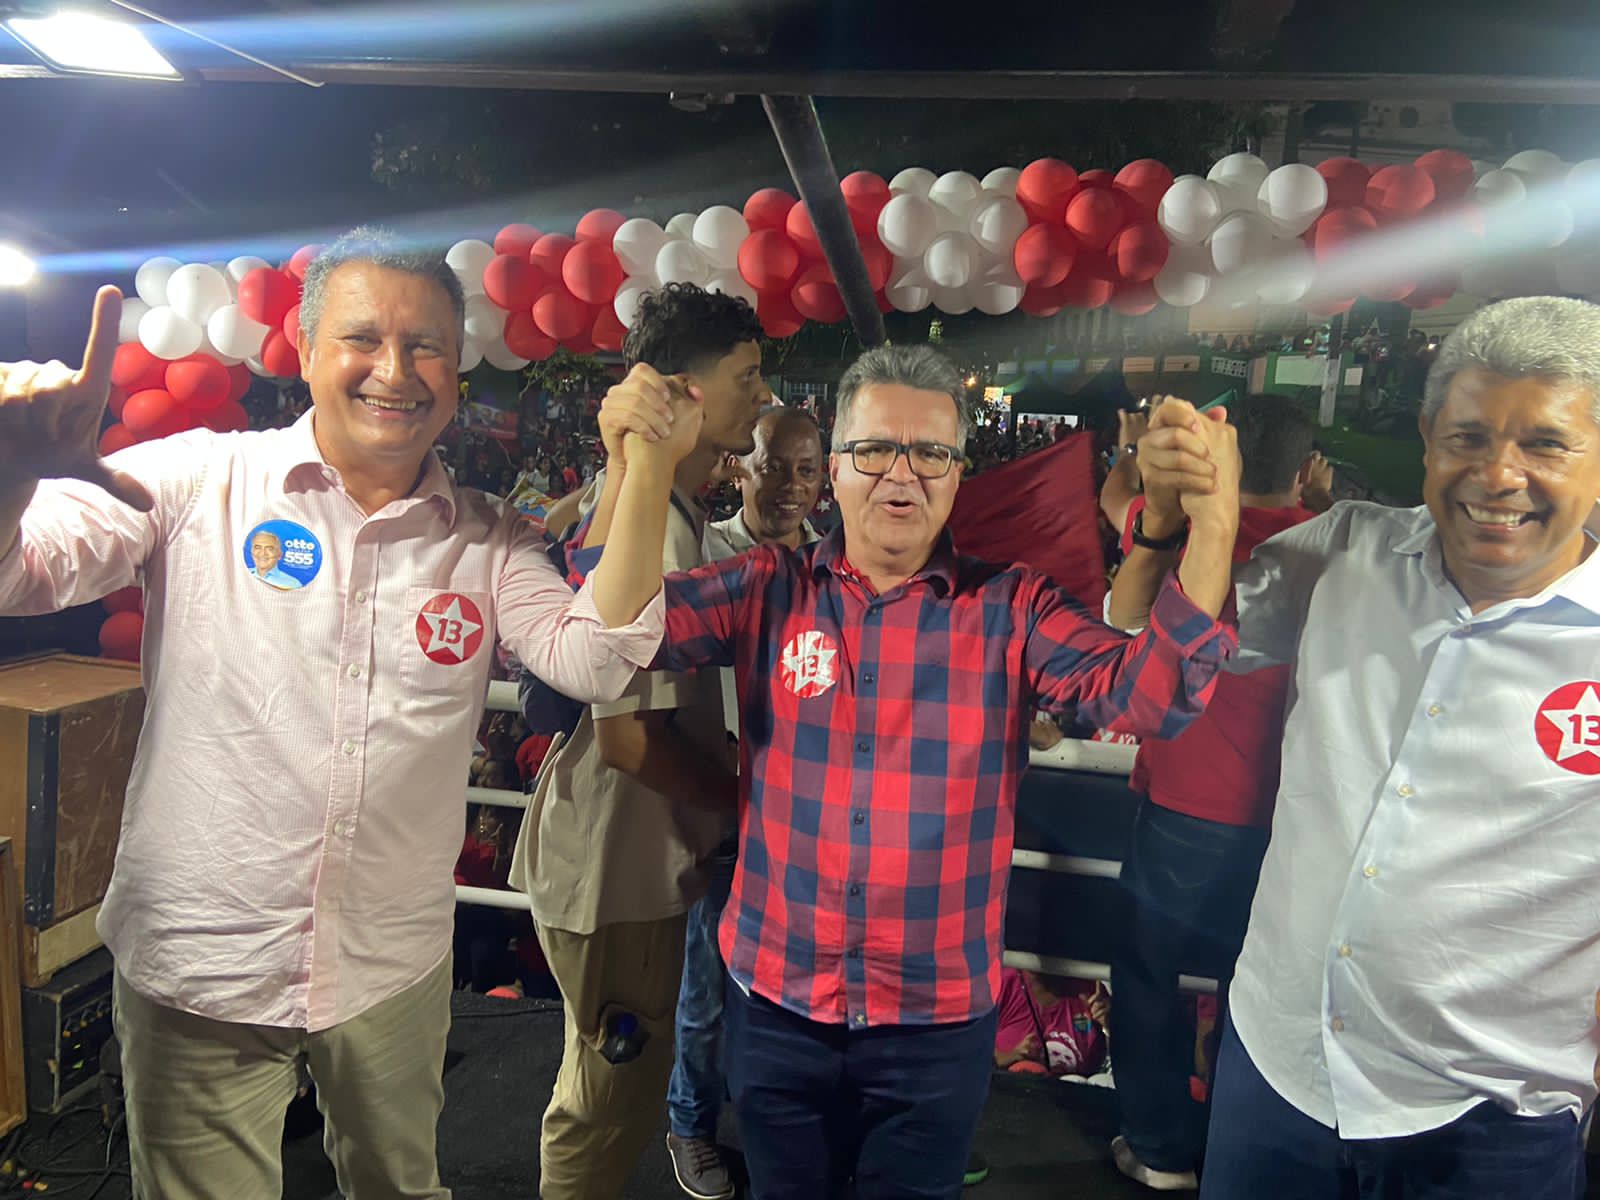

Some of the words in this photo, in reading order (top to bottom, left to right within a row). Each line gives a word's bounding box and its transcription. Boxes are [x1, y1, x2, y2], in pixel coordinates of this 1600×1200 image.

[284, 539, 315, 551] otto
[283, 551, 314, 566] 555
[438, 618, 463, 644] 13
[1567, 713, 1600, 746] 13
